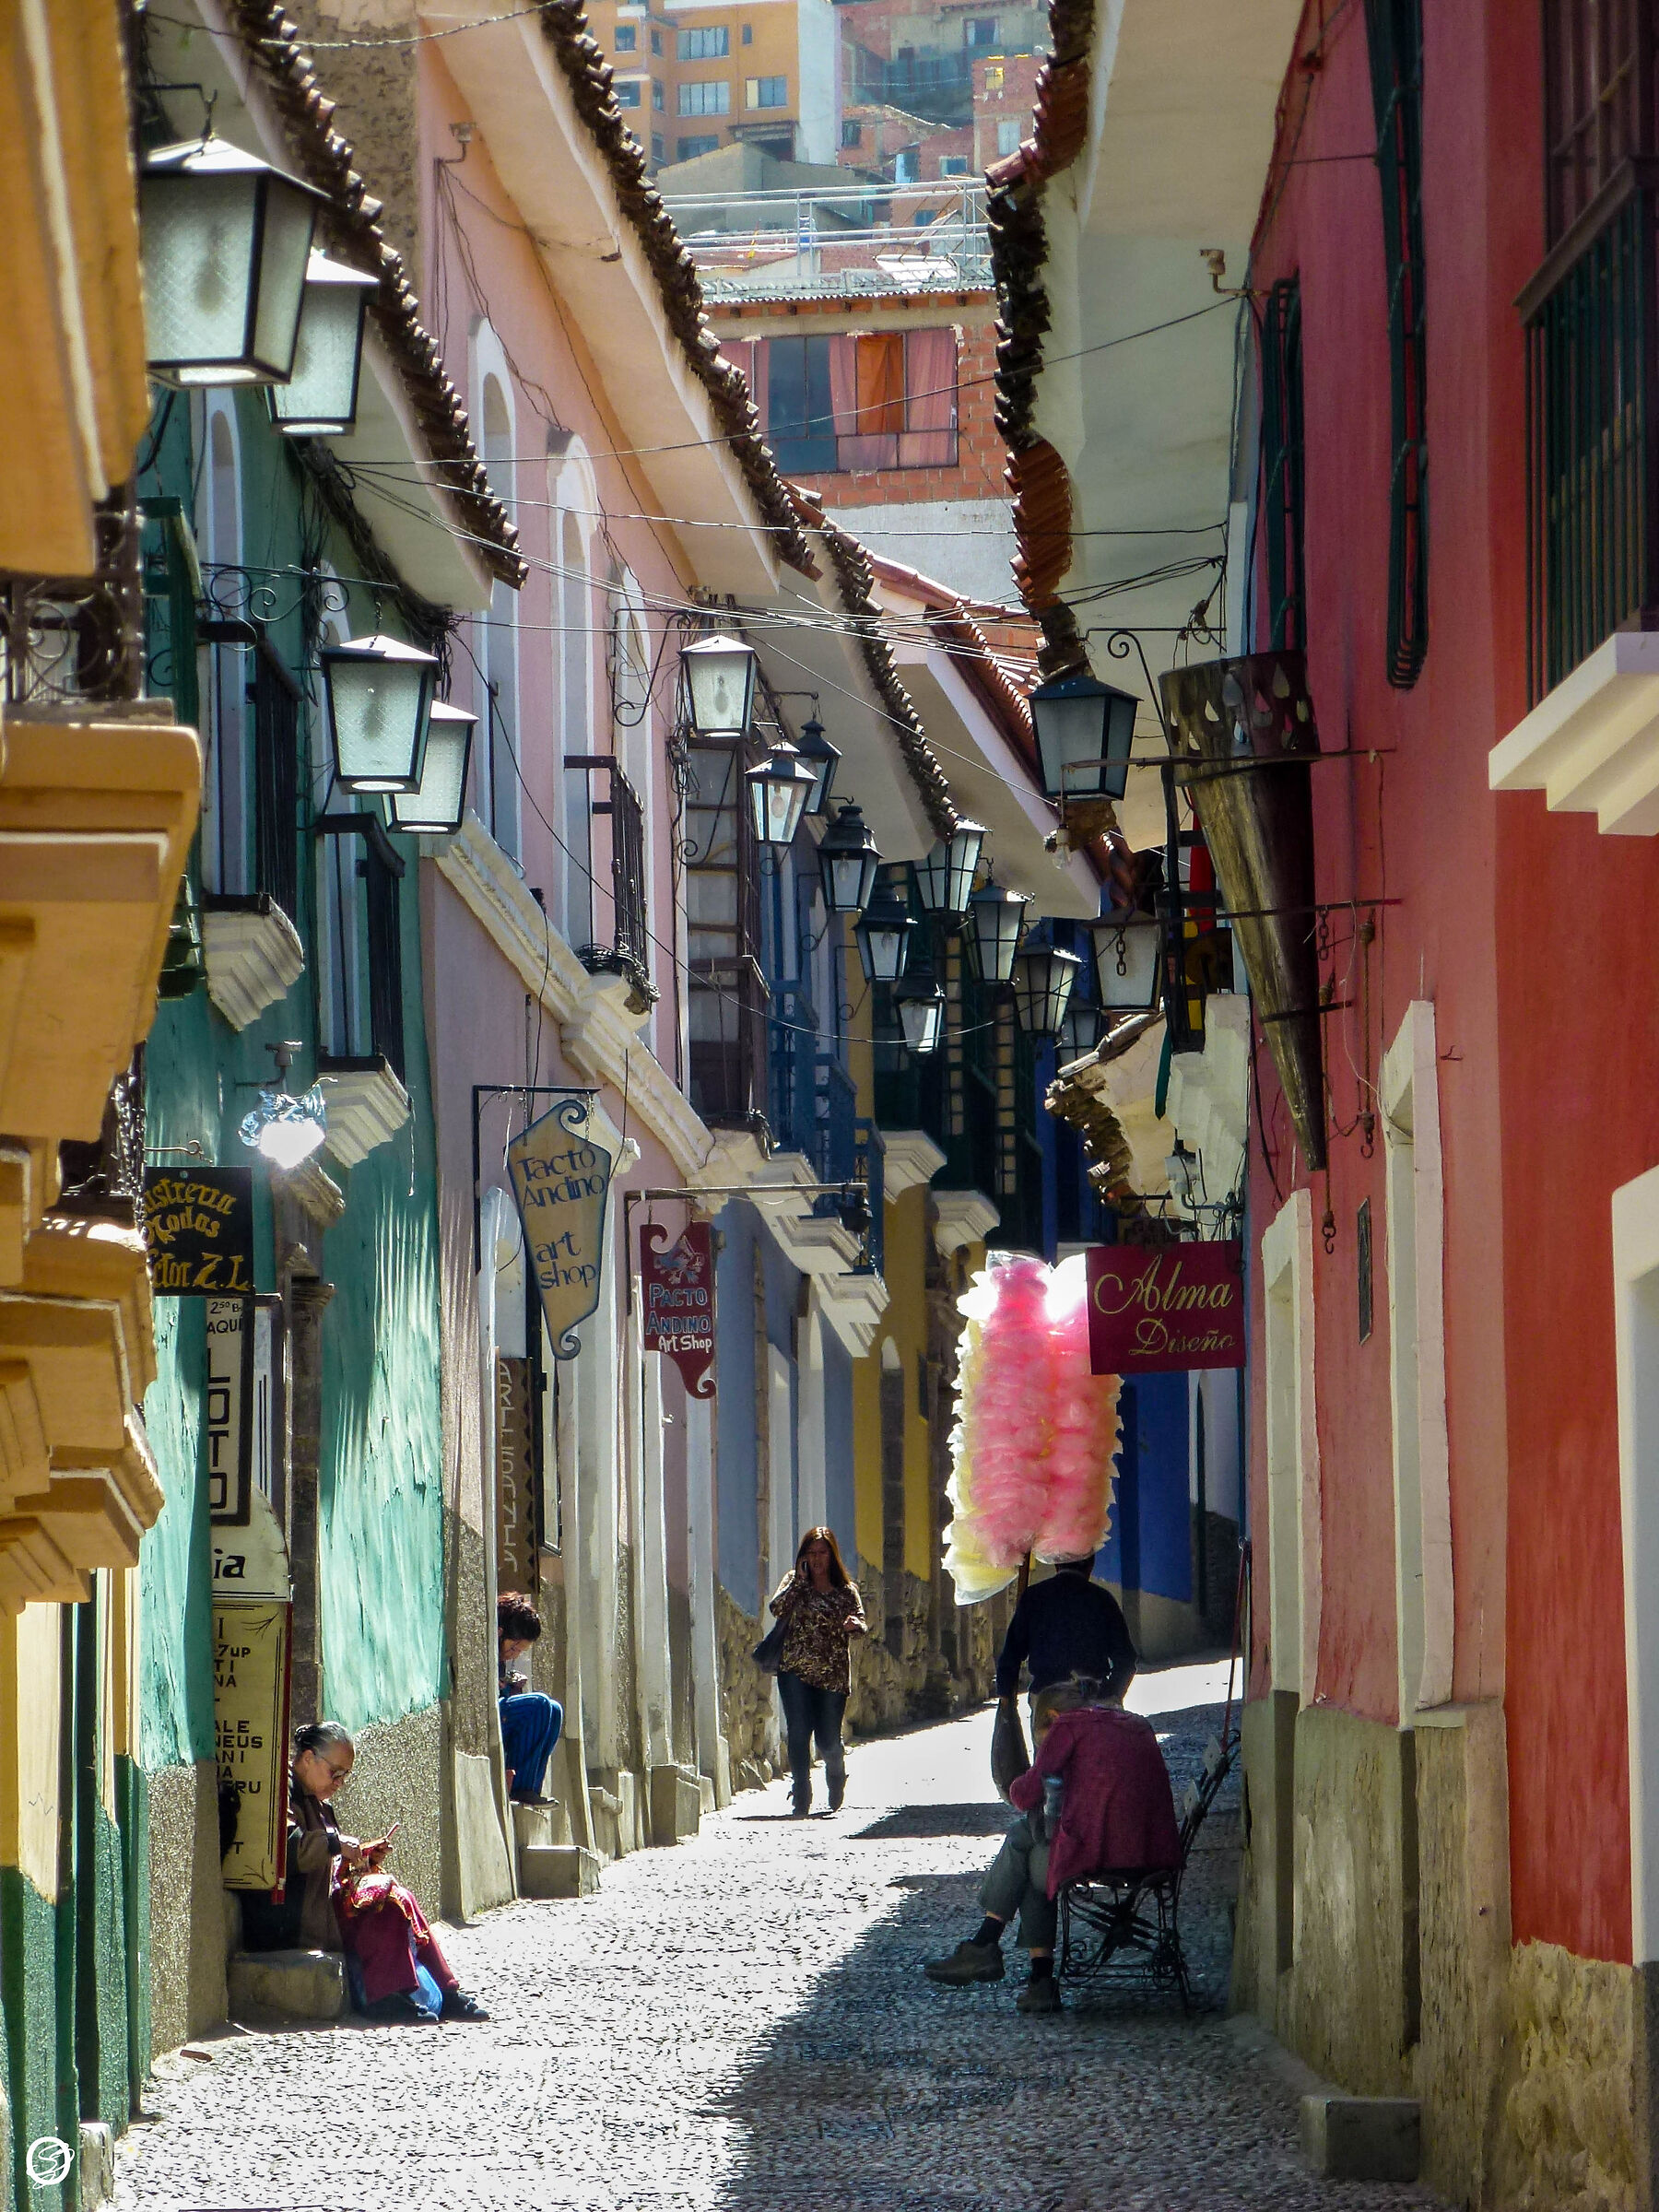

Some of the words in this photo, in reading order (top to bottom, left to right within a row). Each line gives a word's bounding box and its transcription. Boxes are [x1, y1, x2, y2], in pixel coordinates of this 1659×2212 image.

[523, 1174, 605, 1210] Andino
[535, 1231, 582, 1263] art
[540, 1261, 596, 1289] shop
[1094, 1253, 1234, 1314] Alma
[649, 1282, 708, 1308] PACTO
[645, 1311, 712, 1335] ANDINO
[1128, 1317, 1236, 1356] Diseño
[658, 1335, 679, 1353] Art
[680, 1334, 712, 1354] Shop
